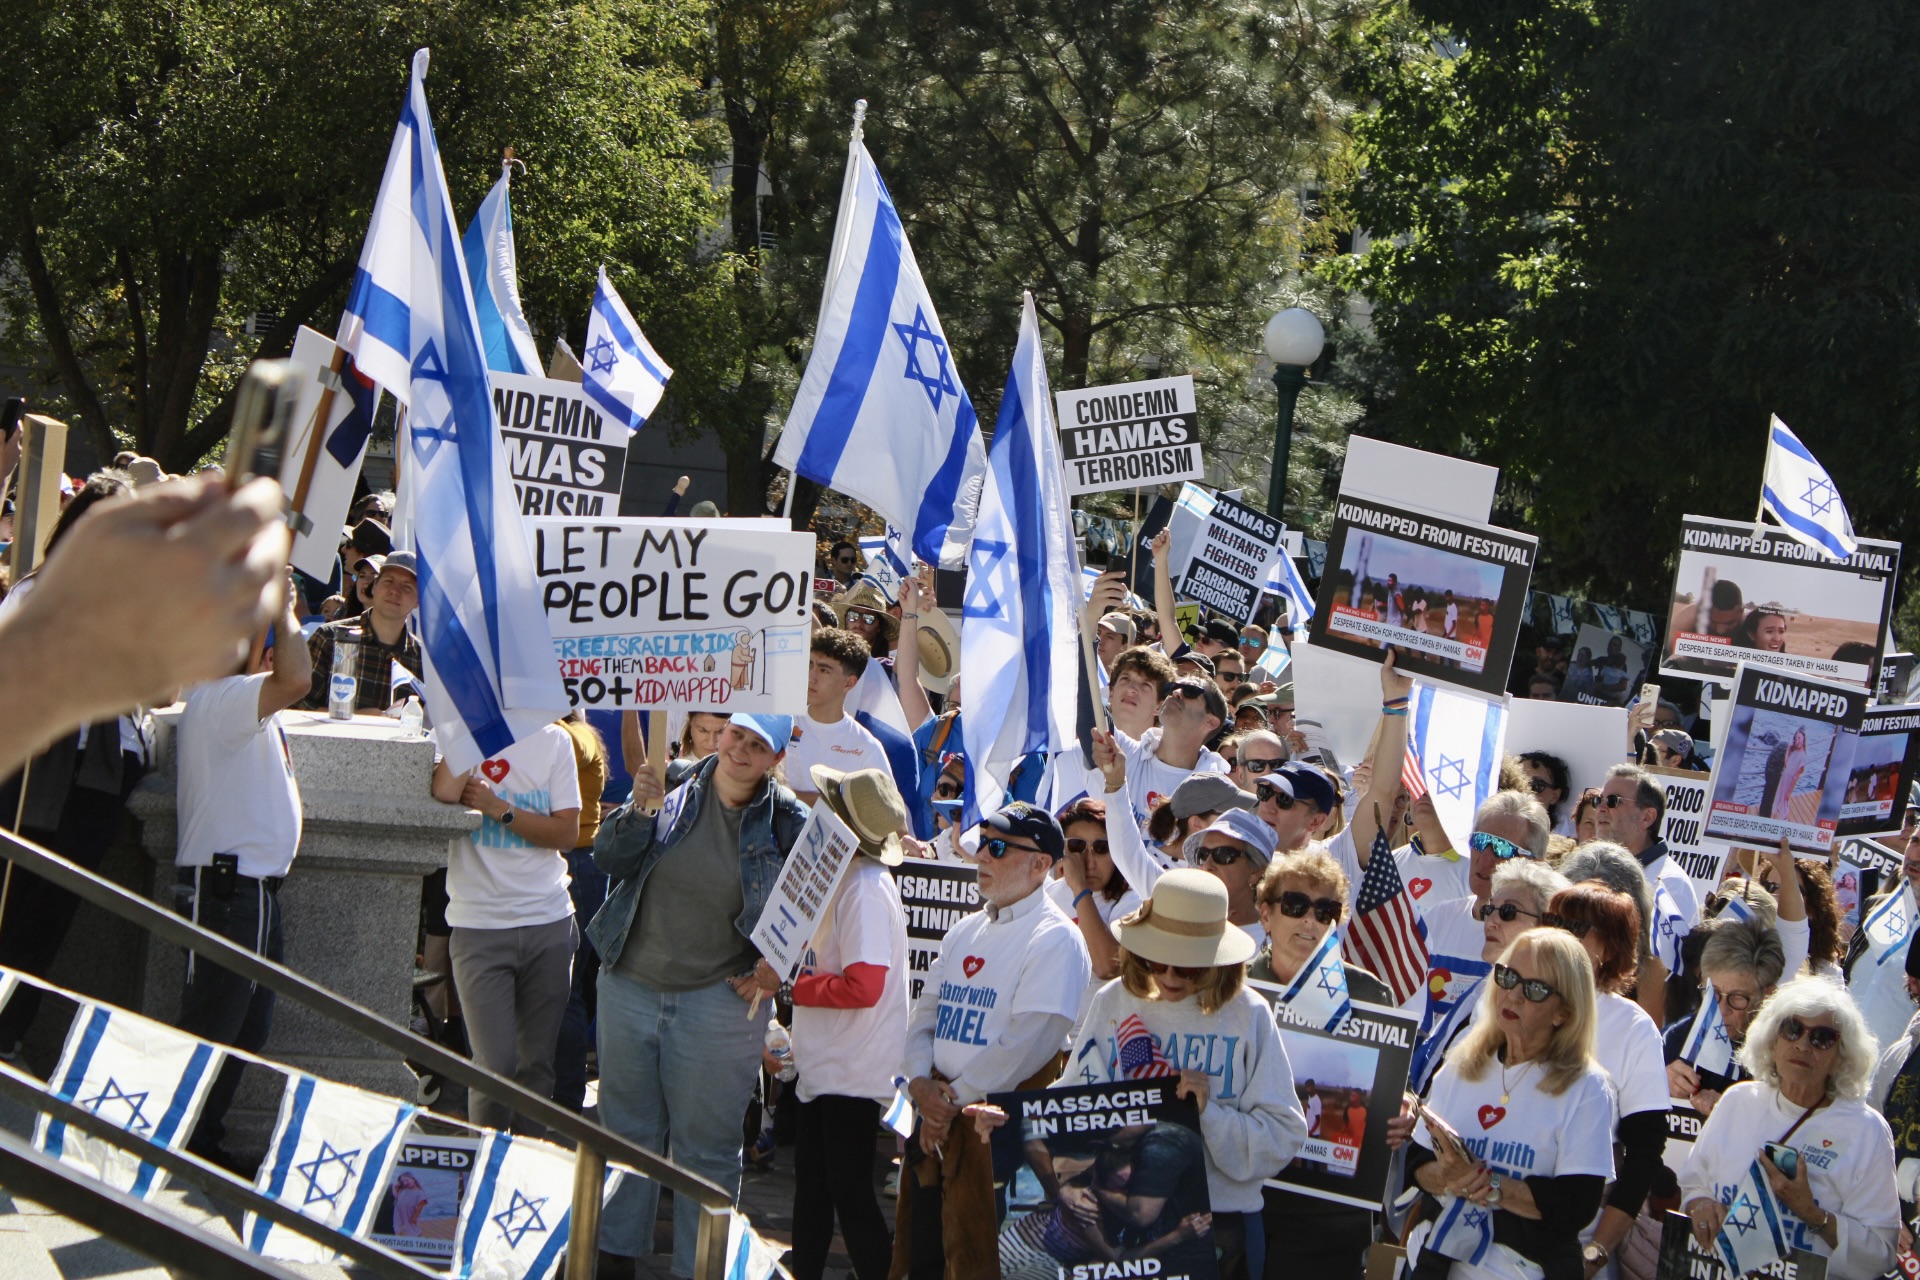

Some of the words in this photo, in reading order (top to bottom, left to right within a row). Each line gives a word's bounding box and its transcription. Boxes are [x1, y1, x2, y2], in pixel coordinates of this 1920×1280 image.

[1076, 388, 1179, 425] CONDEMN
[1074, 418, 1188, 456] HAMAS
[1074, 447, 1193, 486] TERRORISM
[1215, 500, 1276, 540] HAMAS
[1337, 502, 1419, 538] KIDNAPPED
[1420, 524, 1462, 549] FROM
[1463, 536, 1530, 567] FESTIVAL
[536, 526, 621, 577] LET
[633, 528, 708, 568] MY
[1207, 523, 1268, 563] MILITANTS
[1684, 529, 1771, 555] KIDNAPPED
[1773, 541, 1818, 562] FROM
[1202, 543, 1258, 581] FIGHTERS
[543, 571, 709, 623] PEOPLE
[723, 570, 809, 618] GO!
[1184, 577, 1250, 621] TERRORISTS
[1194, 565, 1251, 604] BARBARIC
[1336, 605, 1359, 618] BREAKING
[1360, 611, 1375, 620] NEWS
[1334, 616, 1361, 632] DESPERATE
[1362, 623, 1382, 637] SEARCH
[1382, 628, 1393, 638] FOR
[1393, 631, 1419, 645] HOSTAGES
[1420, 637, 1435, 649] TAKEN
[1435, 640, 1443, 650] BY
[1443, 643, 1461, 656] HAMAS
[1680, 632, 1709, 643] BREAKING
[1465, 647, 1482, 660] CNN
[1678, 643, 1712, 657] DESPERATE
[1713, 648, 1737, 660] SEARCH
[1739, 651, 1751, 661] FOR
[1752, 653, 1784, 666] HOSTAGES
[1785, 657, 1805, 668] TAKEN
[1806, 660, 1815, 670] BY
[1815, 662, 1838, 673] HAMAS
[634, 677, 731, 704] KIDNAPPED
[1755, 679, 1848, 718] KIDNAPPED
[1666, 785, 1705, 813] CHOO
[1714, 802, 1733, 812] BREAKING
[1733, 806, 1746, 814] NEWS
[1711, 815, 1736, 829] DESPERATE
[1736, 820, 1749, 832] SEARCH
[1750, 822, 1758, 832] FOR
[1758, 823, 1779, 836] HOSTAGES
[1779, 827, 1792, 838] TAKEN
[1792, 829, 1798, 839] BY
[1798, 831, 1814, 841] HAMAS
[1816, 831, 1830, 843] CNN
[896, 875, 980, 905] ISRAELIS
[967, 985, 997, 1009] with
[1022, 1088, 1163, 1118] MASSACRE
[1031, 1115, 1058, 1136] IN
[1065, 1108, 1158, 1132] ISRAEL
[1304, 1143, 1327, 1157] HAMAS
[1333, 1147, 1354, 1161] CNN
[1338, 1137, 1353, 1145] LIVE
[1491, 1140, 1536, 1170] with
[1073, 1257, 1162, 1280] STAND
